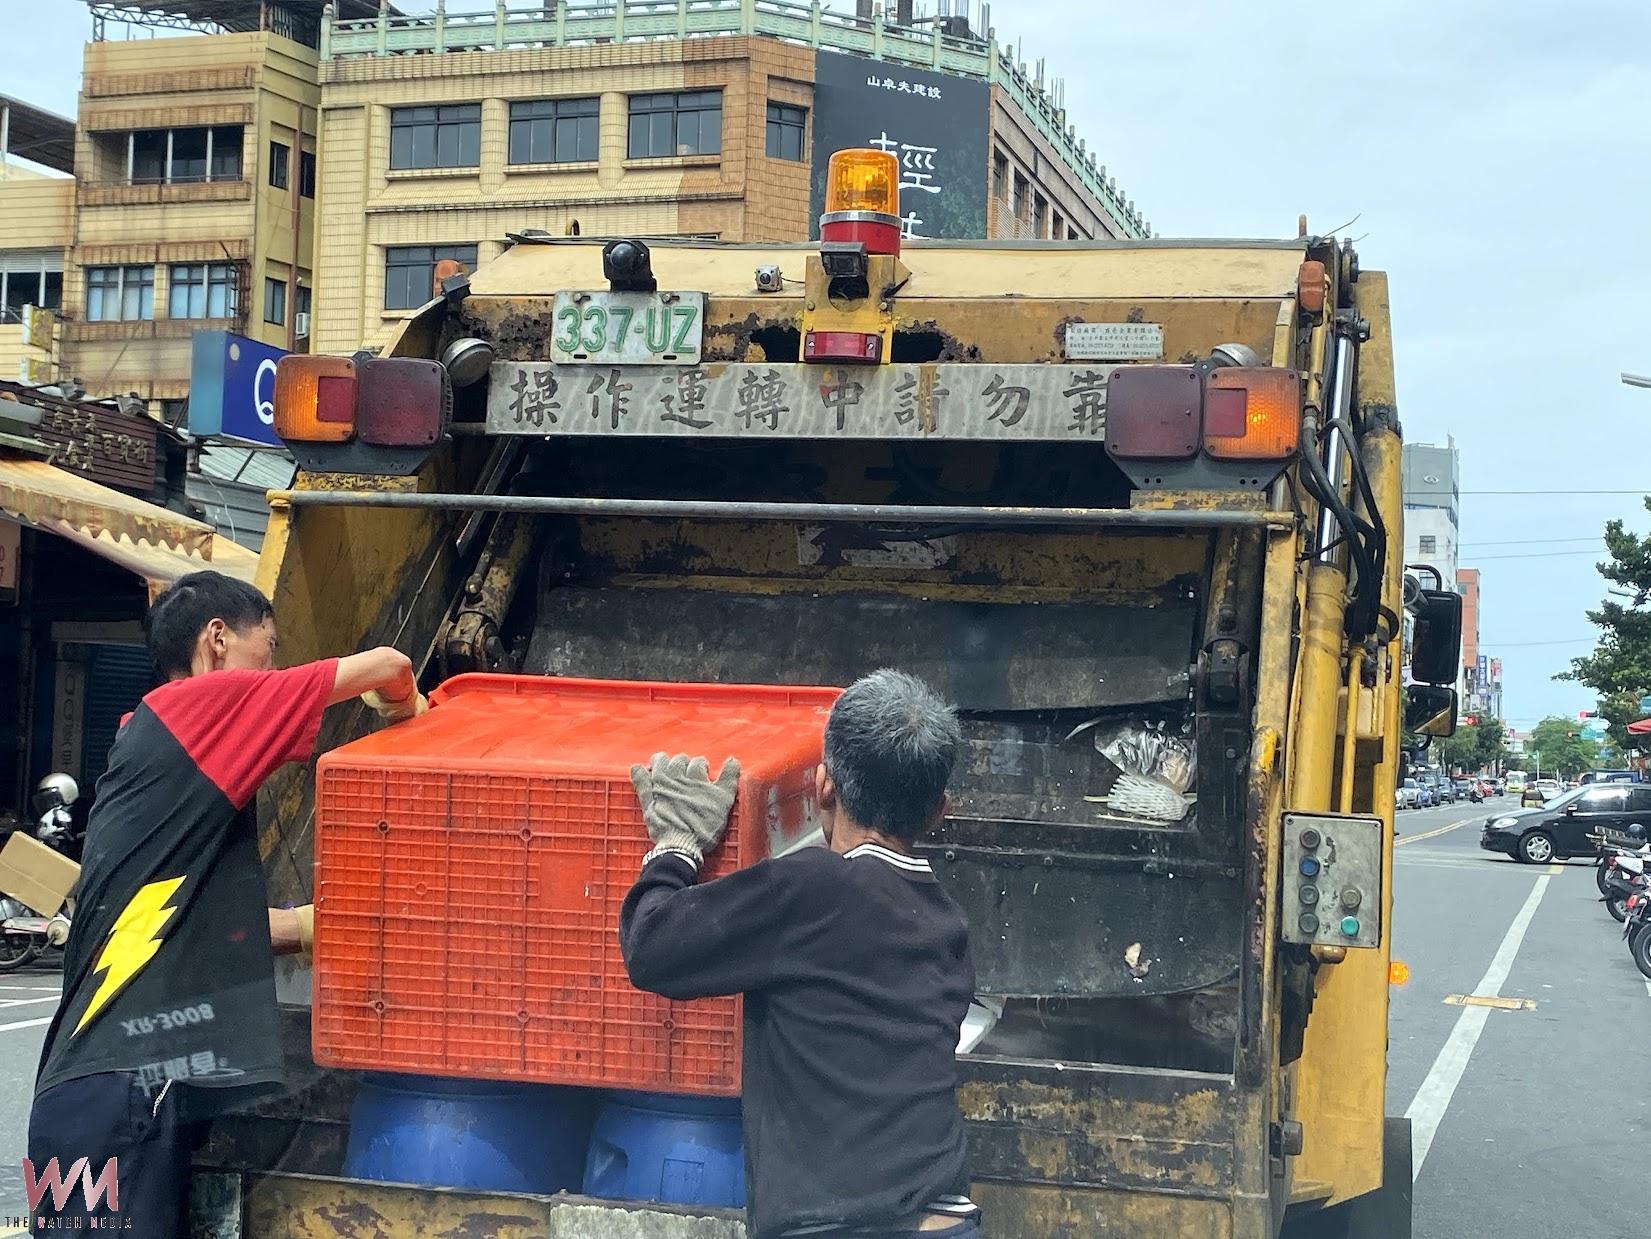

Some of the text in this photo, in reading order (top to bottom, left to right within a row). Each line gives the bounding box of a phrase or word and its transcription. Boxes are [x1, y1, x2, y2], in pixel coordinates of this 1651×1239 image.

[867, 75, 942, 99] 山卓夫建設
[555, 305, 697, 353] 337-UZ
